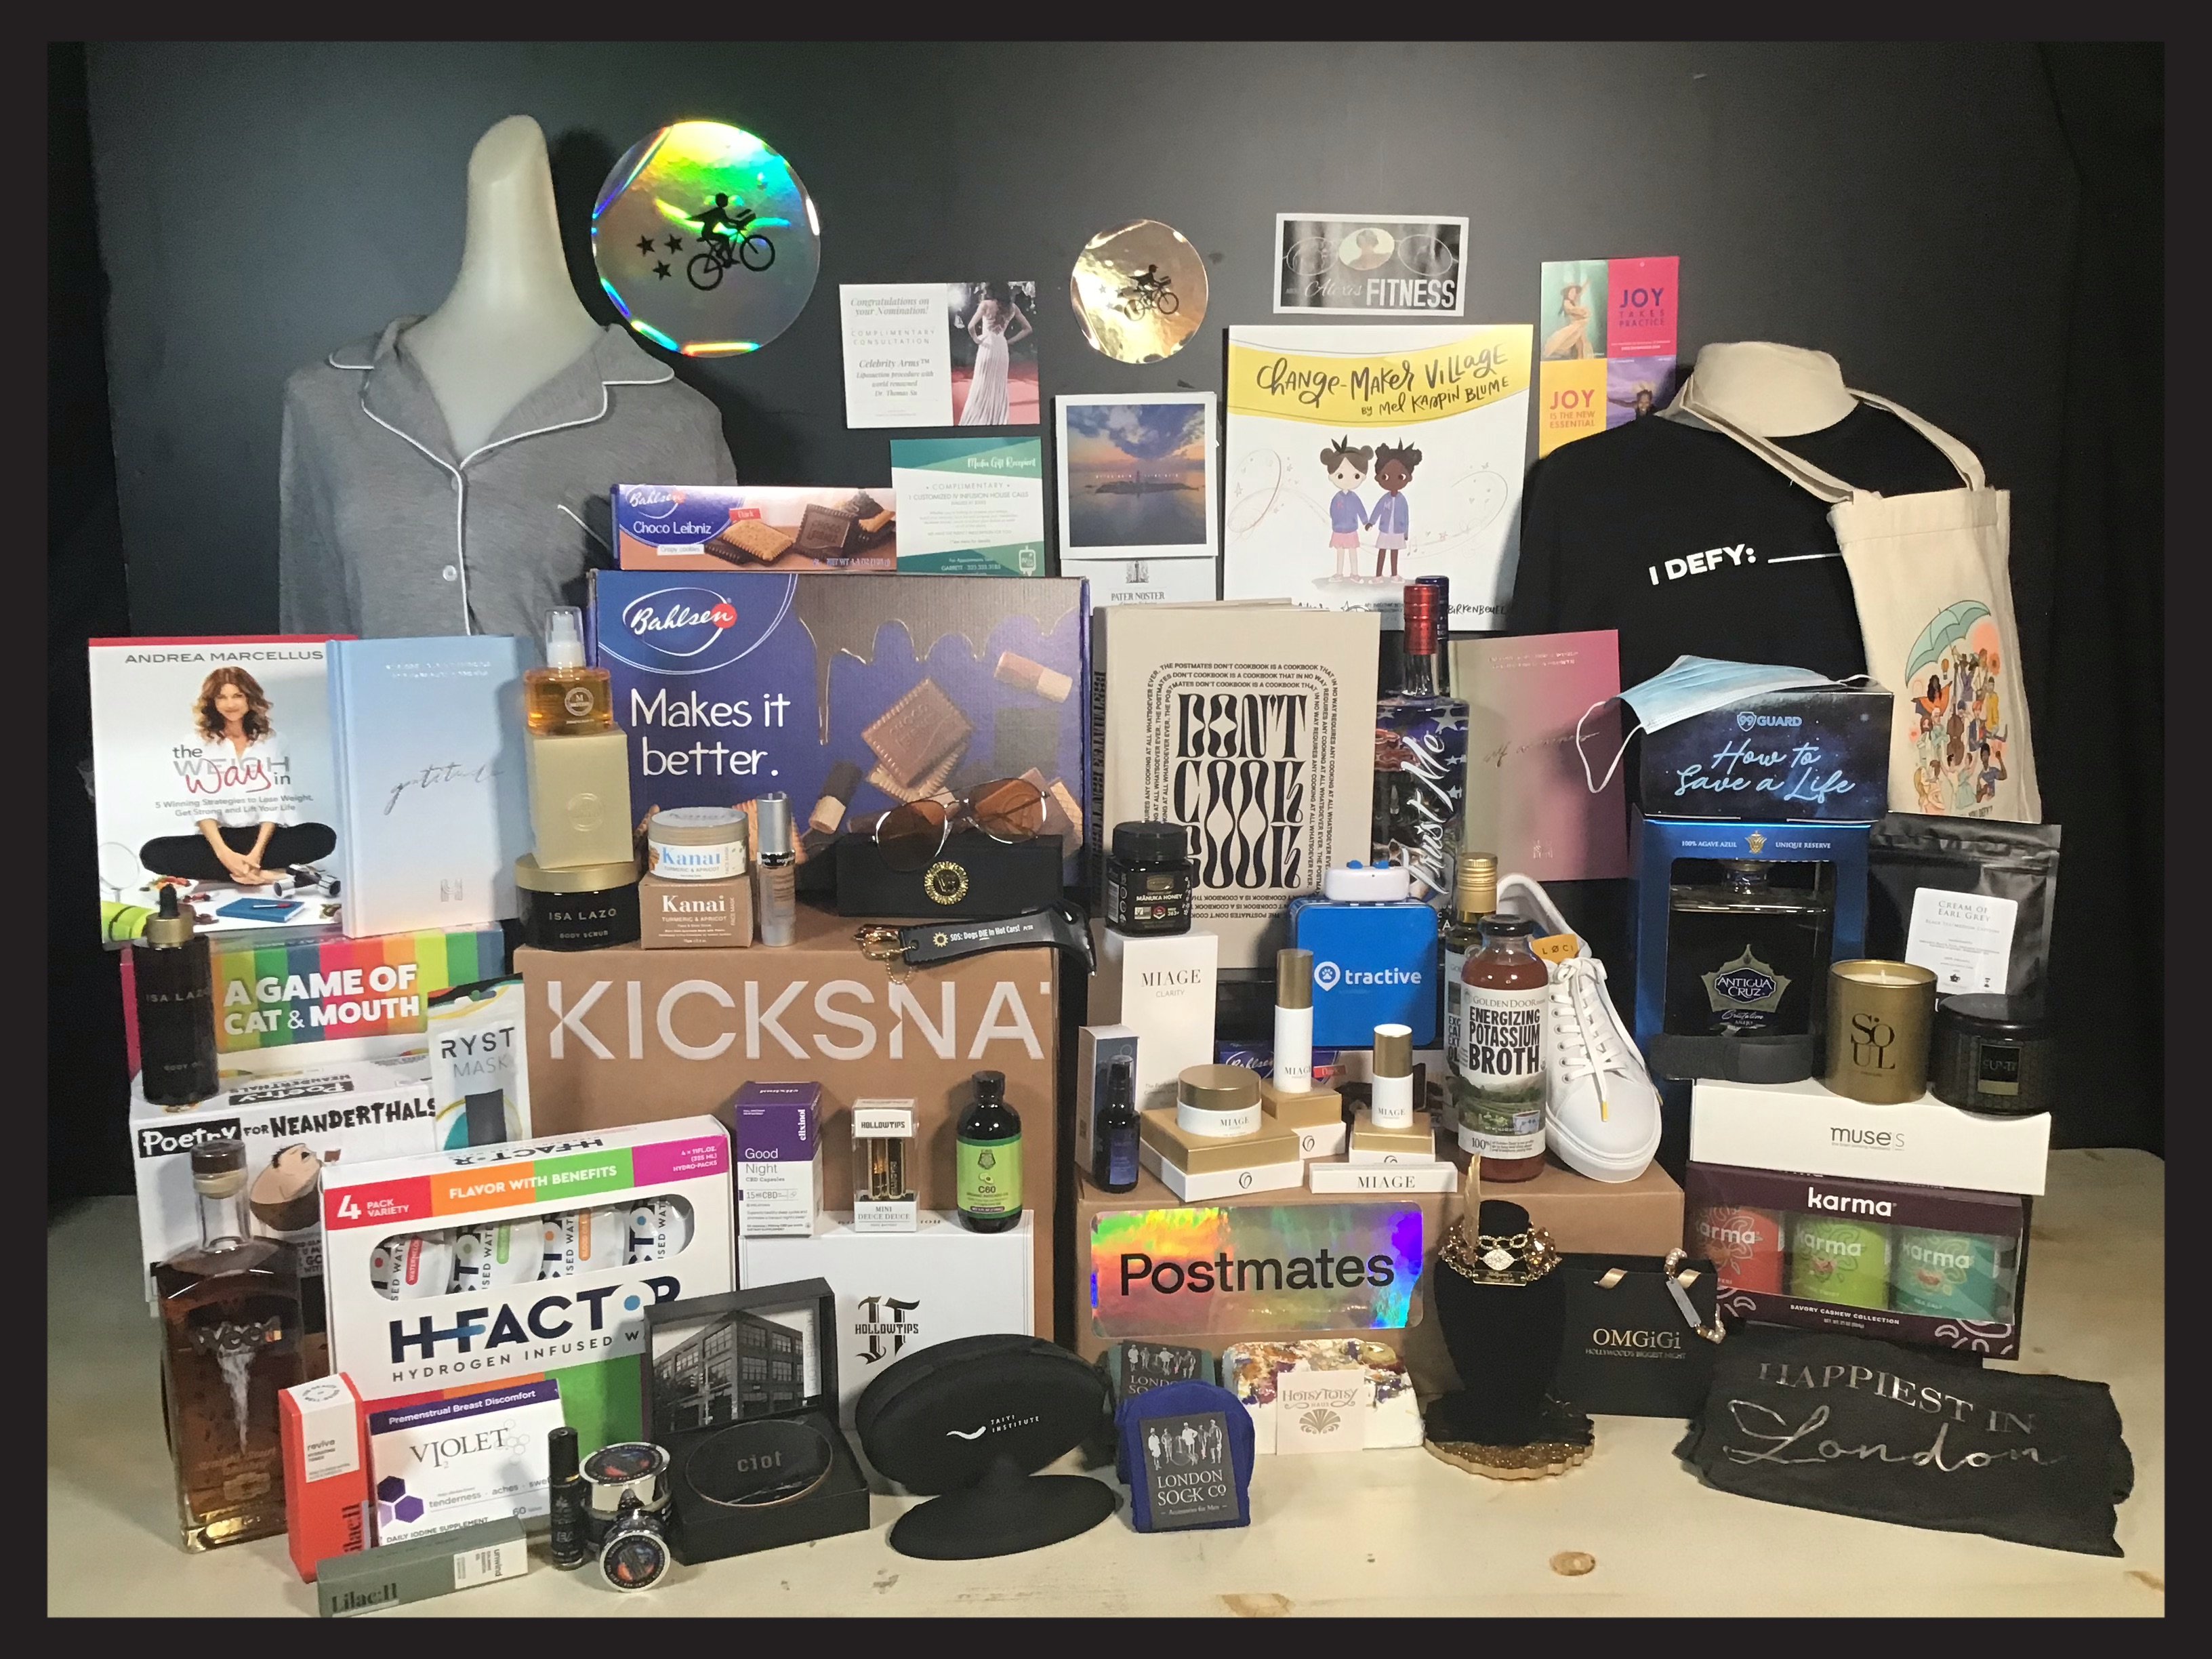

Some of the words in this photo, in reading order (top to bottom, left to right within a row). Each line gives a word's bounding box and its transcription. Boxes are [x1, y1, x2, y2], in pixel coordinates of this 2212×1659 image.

[851, 297, 917, 307] Congratulations
[1366, 279, 1455, 308] FITNESS
[1619, 288, 1664, 308] JOY
[855, 308, 874, 316] your
[876, 306, 928, 316] Nomination!
[1619, 309, 1664, 319] TAKES
[1619, 318, 1664, 327] PRACTICE
[859, 359, 896, 369] Celebrity
[1379, 392, 1406, 415] Mel
[1465, 376, 1509, 403] BLUME
[1550, 389, 1595, 410] JOY
[1550, 411, 1557, 419] IS
[1559, 411, 1574, 419] THE
[1550, 419, 1595, 428] ESSENTIAL
[932, 483, 1004, 491] COMPLIMENTARY
[633, 520, 670, 535] Choco
[673, 522, 712, 535] Leibniz
[1648, 566, 1660, 586] I
[1664, 544, 1757, 580] DEFY:
[1111, 592, 1133, 601] PATER
[1135, 592, 1165, 600] NOSTER
[630, 605, 733, 635] Bahlsen
[125, 653, 205, 664] ANDREA
[210, 651, 323, 662] MARCELLUS
[1160, 663, 1174, 671] THE
[1319, 665, 1334, 678] THAT
[631, 689, 752, 728] Makes
[764, 693, 790, 727] it
[1175, 693, 1308, 759] DON'T
[1738, 715, 1755, 728] 99
[1757, 716, 1802, 727] GUARD
[172, 744, 203, 759] the
[642, 735, 779, 777] better.
[1711, 738, 1787, 775] How
[1791, 742, 1822, 769] to
[185, 758, 271, 794] Way
[274, 772, 291, 786] in
[1400, 730, 1454, 813] Me
[1174, 760, 1307, 823] COOK
[1674, 764, 1752, 796] Save
[1756, 779, 1784, 793] a
[1784, 767, 1856, 804] Life
[163, 799, 200, 808] Winning
[203, 797, 245, 806] Strategies
[175, 808, 192, 817] Get
[193, 806, 222, 817] Strong
[243, 804, 256, 813] Lift
[280, 802, 295, 811] Life
[1400, 788, 1450, 895] Trust
[661, 847, 721, 866] Kanai
[661, 895, 726, 913] Kanai
[1938, 900, 1972, 912] CREAM
[548, 911, 573, 922] ISA
[578, 908, 617, 920] LAZO
[1938, 908, 1961, 918] EARL
[1965, 912, 1990, 922] GREY
[559, 931, 581, 940] BODY
[583, 930, 609, 939] SCRUB
[950, 933, 964, 942] SOS:
[964, 931, 978, 940] Dogs
[978, 928, 989, 938] DIE
[995, 926, 1006, 935] Hot
[1006, 924, 1021, 933] Cars!
[224, 979, 253, 1007] A
[255, 968, 364, 1004] GAME
[369, 962, 417, 991] OF
[1141, 969, 1202, 989] MIAGE
[1345, 966, 1422, 985] tractive
[1717, 977, 1771, 989] ANTIGUA
[1155, 989, 1185, 998] CLARITY
[1727, 985, 1762, 998] CRUZ
[224, 1008, 283, 1036] CAT
[286, 1009, 306, 1029] &
[309, 994, 419, 1027] MOUTH
[547, 979, 1050, 1061] KICKSNA
[1469, 1006, 1540, 1026] ENERGIZING
[440, 1026, 516, 1061] RYST
[1469, 1021, 1540, 1048] POTASSIUM
[452, 1052, 509, 1079] MASK
[1469, 1042, 1540, 1076] BROTH
[270, 1097, 436, 1139] NEANDERTHALS
[798, 1109, 806, 1141] elixinol
[861, 1121, 905, 1130] HOLLOWTIPS
[243, 1123, 269, 1137] FOR
[1830, 1127, 1891, 1146] muse
[745, 1147, 779, 1160] Good
[673, 1160, 718, 1172] HYDRO-PACKS
[745, 1163, 778, 1176] Night
[449, 1181, 506, 1200] FLAVOR
[510, 1174, 548, 1191] WITH
[552, 1164, 617, 1187] BENEFITS
[978, 1185, 996, 1193] C60
[1357, 1175, 1416, 1189] MIAGE
[762, 1191, 778, 1199] CBD
[1807, 1187, 1893, 1217] karma
[336, 1194, 362, 1221] 4
[367, 1197, 394, 1210] PACK
[367, 1204, 409, 1217] VARIETY
[875, 1205, 893, 1213] MINI
[884, 1212, 911, 1221] DEUCE
[1120, 1248, 1395, 1296] Postmates
[1790, 1304, 1818, 1313] SAVORY
[1820, 1308, 1851, 1318] CASHEW
[1853, 1313, 1900, 1325] COLLECTION
[855, 1323, 919, 1335] HOLLOWTIPS
[1593, 1328, 1681, 1349] OMGiGi
[525, 1335, 613, 1361] INFUSED
[392, 1354, 511, 1382] HYDROGEN
[388, 1405, 451, 1425] Premenstrual
[453, 1399, 483, 1415] Breast
[485, 1389, 535, 1408] Discomfort
[1759, 1362, 1973, 1422] HAPPIEST
[1986, 1410, 2034, 1435] IN
[990, 1414, 1016, 1425] TAIYI
[991, 1416, 1040, 1434] INSTITUTE
[307, 1439, 335, 1451] revive
[1723, 1400, 2066, 1471] London
[410, 1428, 508, 1468] VIOLET
[1158, 1469, 1223, 1489] LONDON
[429, 1492, 482, 1508] tenderness
[492, 1483, 519, 1495] aches
[1158, 1487, 1204, 1506] SOCK
[386, 1532, 409, 1543] DAILY
[411, 1527, 438, 1538] IODINE
[439, 1516, 489, 1533] SUPPLEMENT
[493, 1549, 502, 1577] unwind
